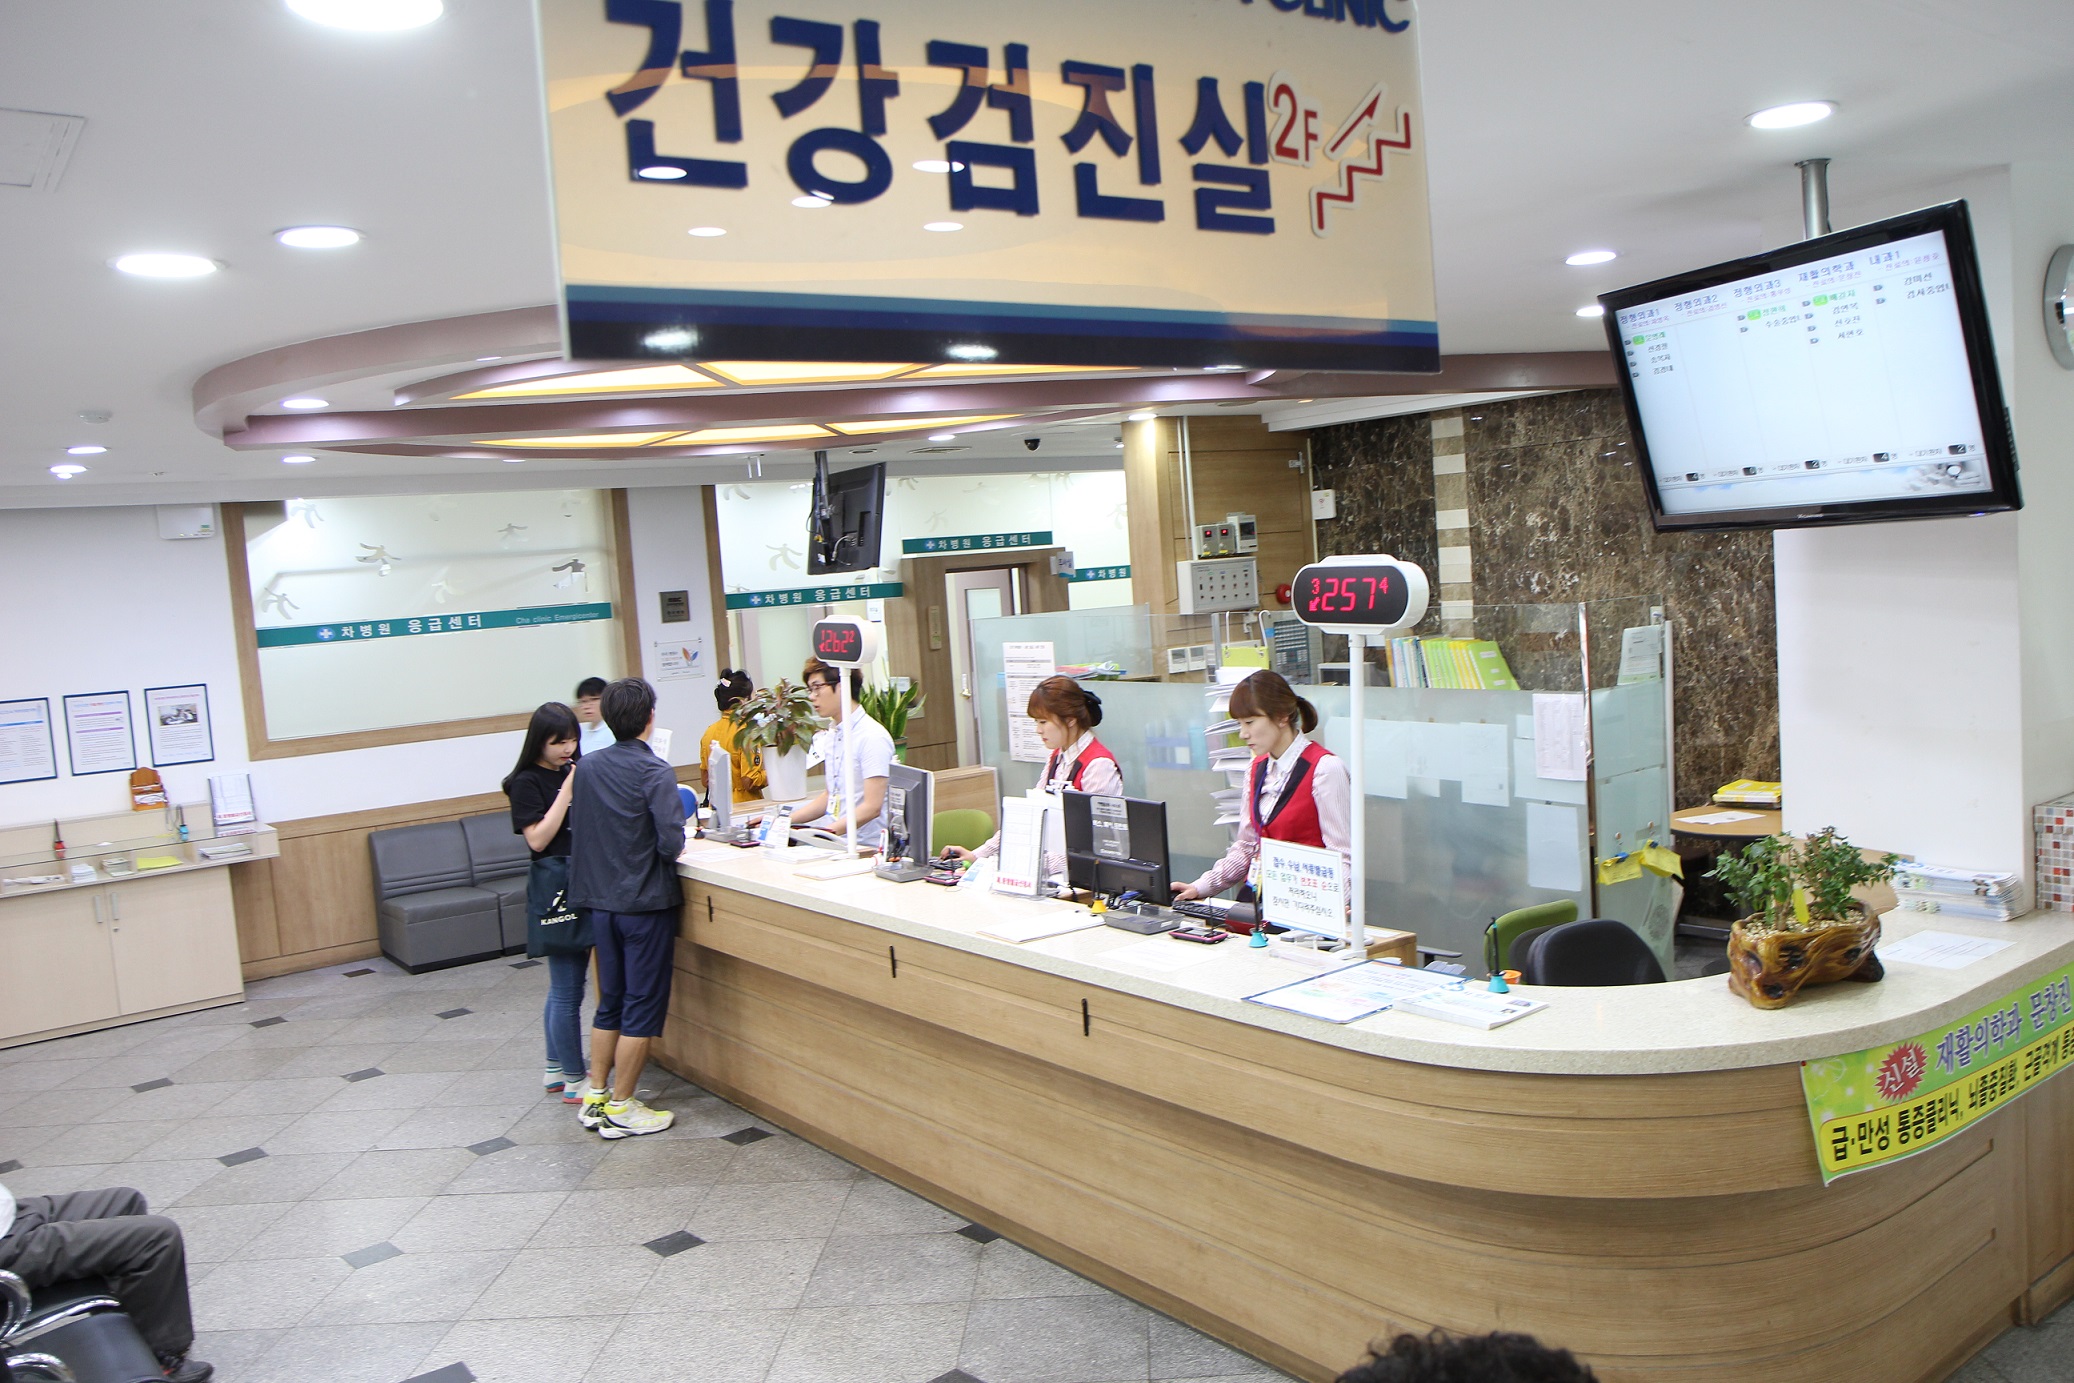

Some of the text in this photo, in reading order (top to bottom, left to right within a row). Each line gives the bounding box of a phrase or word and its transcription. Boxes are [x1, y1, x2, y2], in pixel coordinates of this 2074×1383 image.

[604, 0, 1319, 234] 건강검진실 2F
[1798, 261, 1855, 282] 재활의학과
[1733, 279, 1781, 298] 정형외과3
[1674, 294, 1718, 312] 정형외과2
[1620, 308, 1660, 325] 정형외과1
[938, 533, 1031, 550] 차병원 응급센터
[764, 586, 871, 605] 차병원 응급센터
[341, 614, 482, 639] 차병원 응급센터
[1300, 877, 1318, 888] 번호표
[540, 912, 578, 926] KANGOL
[1882, 974, 2072, 1094] 신설 재활의학과 문창진
[2023, 1034, 2060, 1082] 근골격계
